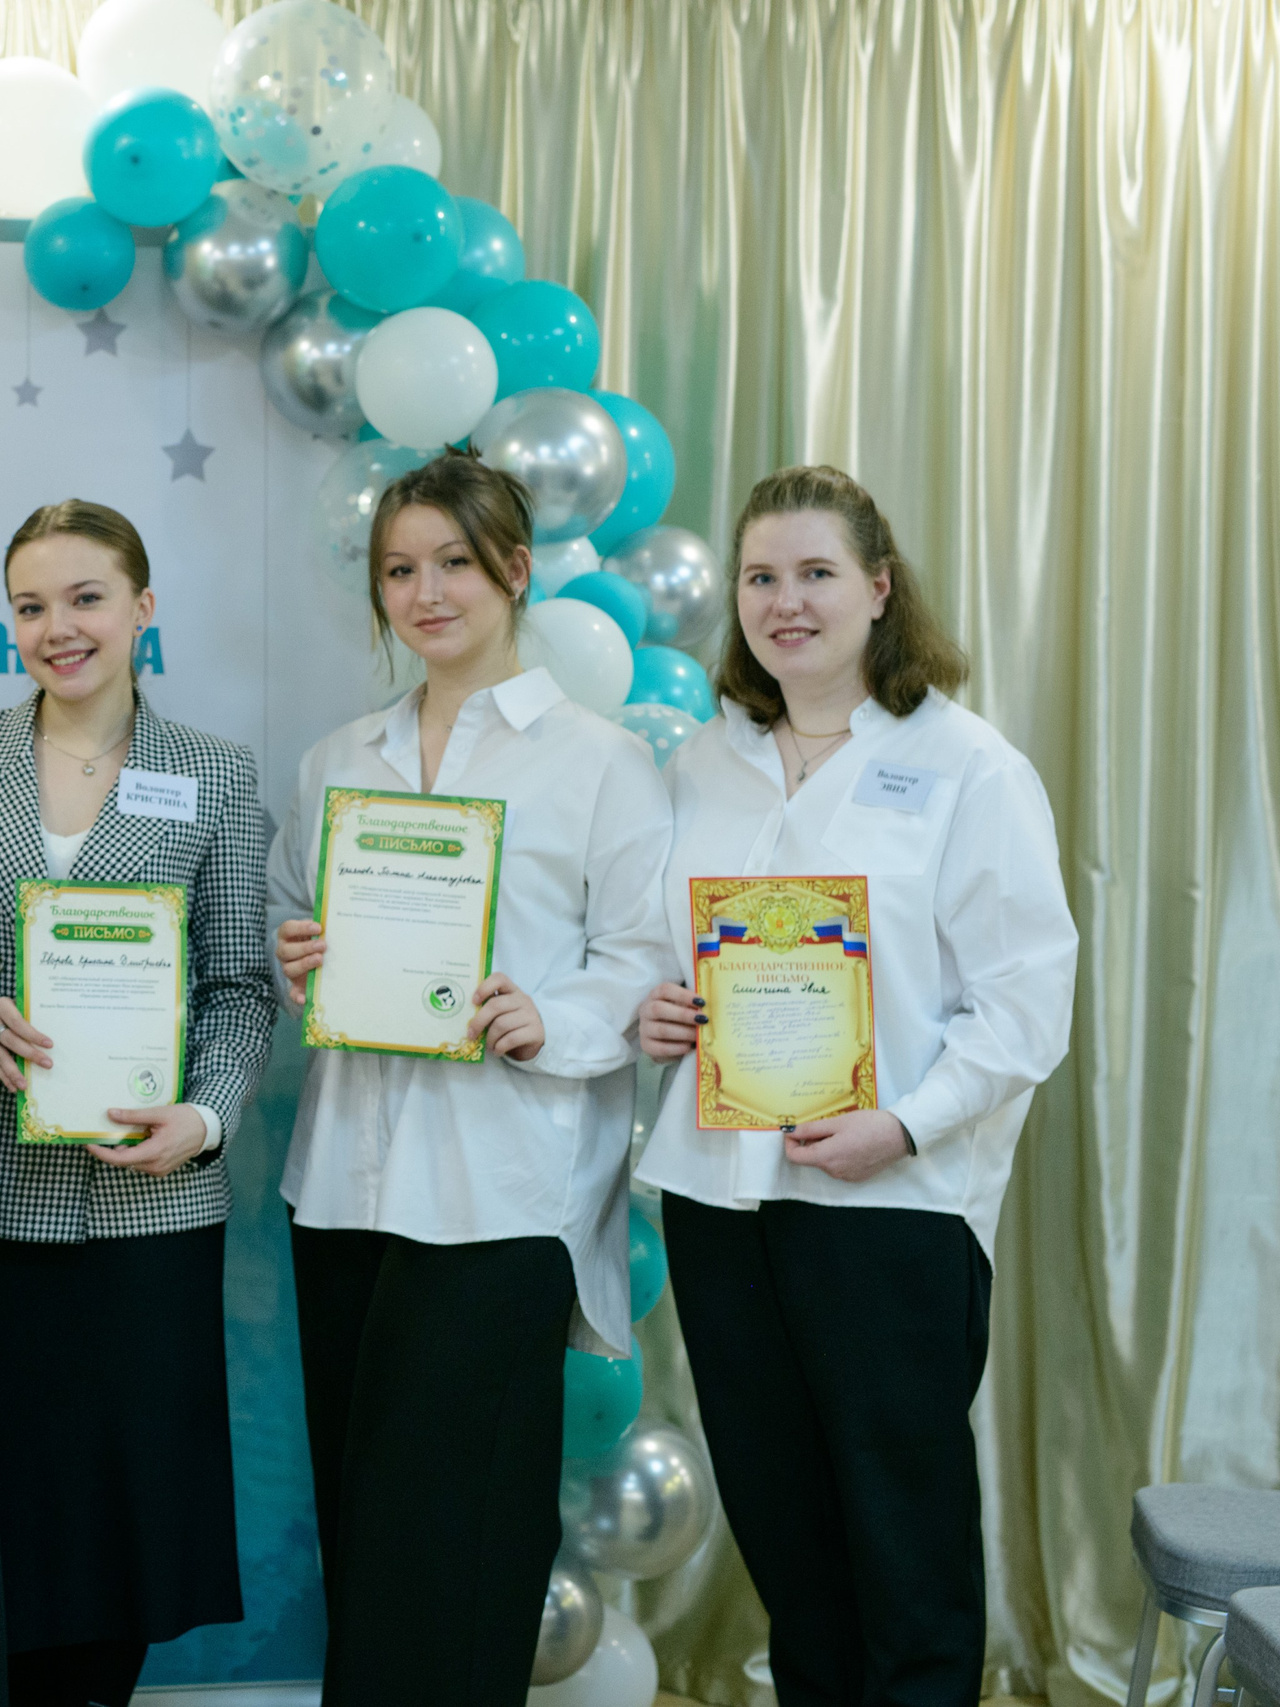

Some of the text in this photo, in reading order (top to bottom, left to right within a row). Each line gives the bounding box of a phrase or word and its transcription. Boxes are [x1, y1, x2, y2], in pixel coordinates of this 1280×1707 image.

[877, 769, 919, 786] Волонтер
[135, 782, 182, 798] Волонтер
[126, 792, 188, 809] КРИСТИНА
[357, 814, 468, 834] Благодарственное
[379, 836, 444, 853] ПИСЬМО
[50, 905, 155, 921] Благодарственное
[73, 926, 135, 939] ПИСЬМО
[719, 961, 847, 972] БЛАГОДАРСТВЕННОЕ
[756, 974, 810, 983] ПИСЬМО
